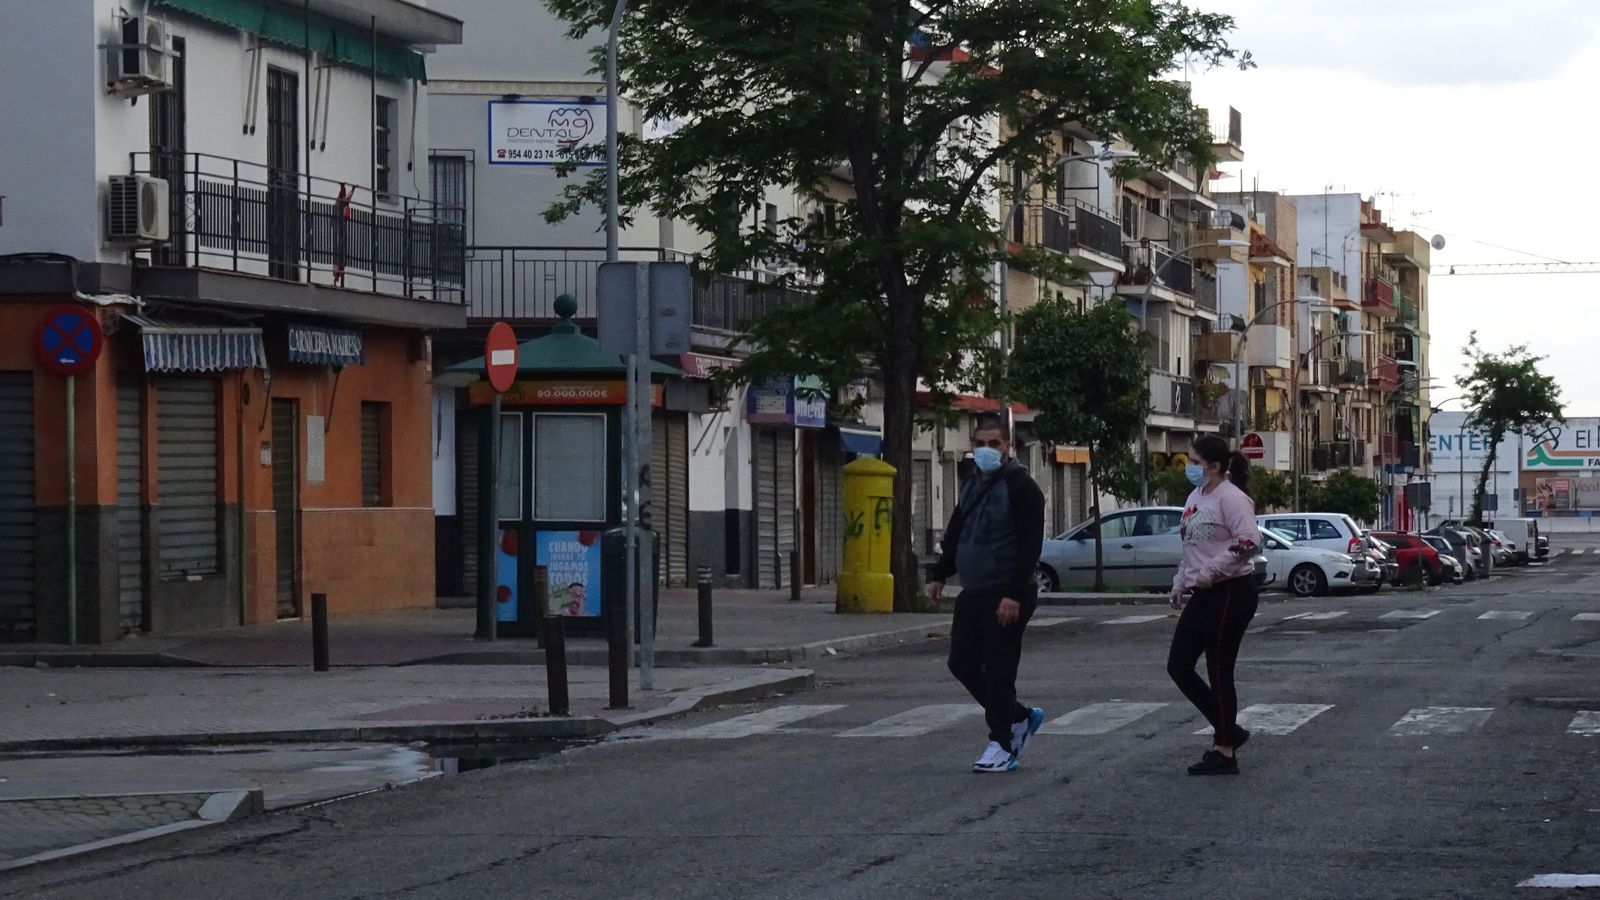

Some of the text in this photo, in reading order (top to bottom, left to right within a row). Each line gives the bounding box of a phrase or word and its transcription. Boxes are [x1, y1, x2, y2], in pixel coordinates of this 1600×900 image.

[506, 127, 581, 138] DENTAL
[508, 149, 521, 159] 954
[523, 149, 532, 159] 40
[534, 149, 543, 159] 23
[545, 149, 554, 159] 74
[549, 541, 588, 553] CUANDO
[549, 561, 588, 571] JUGAMOS
[548, 571, 588, 586] TODOS
